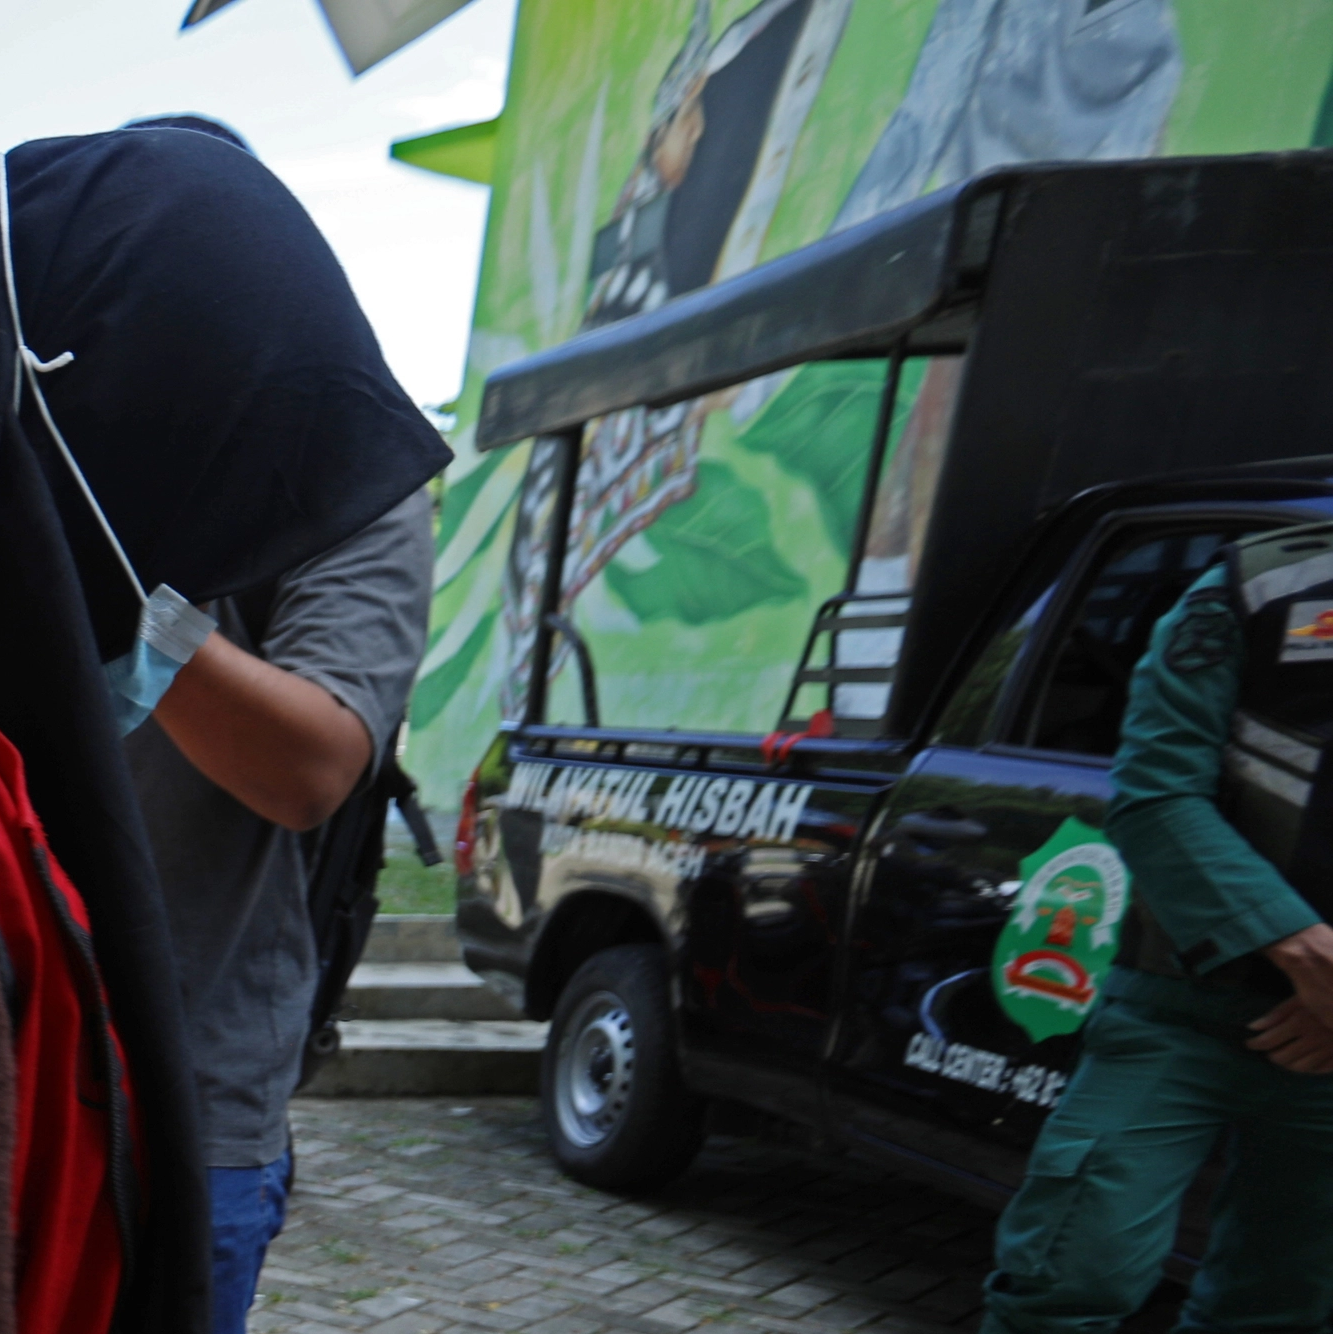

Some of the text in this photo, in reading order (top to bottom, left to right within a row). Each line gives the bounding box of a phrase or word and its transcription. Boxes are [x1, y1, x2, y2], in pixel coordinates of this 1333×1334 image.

[506, 762, 814, 843] WILAYATUL HISBAH
[642, 840, 709, 881] ACEH
[940, 1042, 1009, 1092] CENTER
